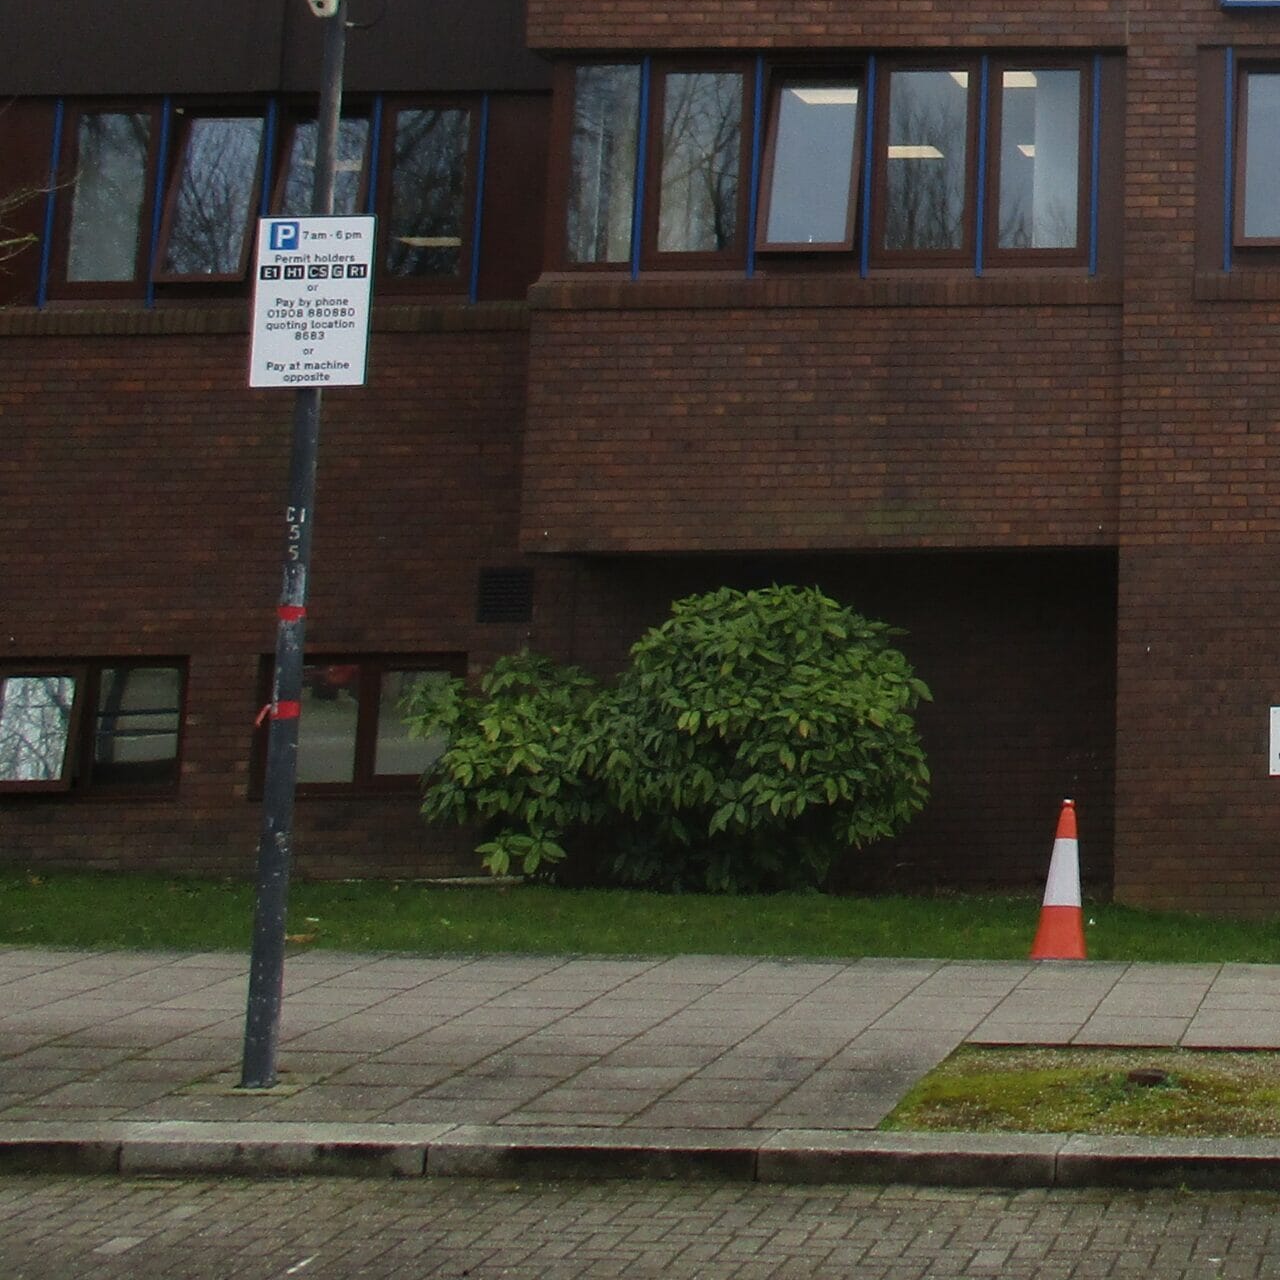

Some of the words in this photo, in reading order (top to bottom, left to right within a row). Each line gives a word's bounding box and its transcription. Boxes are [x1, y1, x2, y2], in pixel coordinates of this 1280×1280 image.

[276, 224, 296, 248] P
[274, 253, 311, 263] Permit
[314, 253, 356, 263] holders
[308, 266, 328, 277] CS
[275, 297, 295, 308] Pay
[299, 297, 311, 308] by
[315, 297, 349, 308] phone
[267, 308, 304, 318] 01908
[265, 320, 308, 331] quoting
[311, 319, 355, 329] location
[266, 361, 286, 372] Pay
[289, 361, 301, 370] at
[304, 360, 350, 370] machine
[283, 372, 331, 383] opposite
